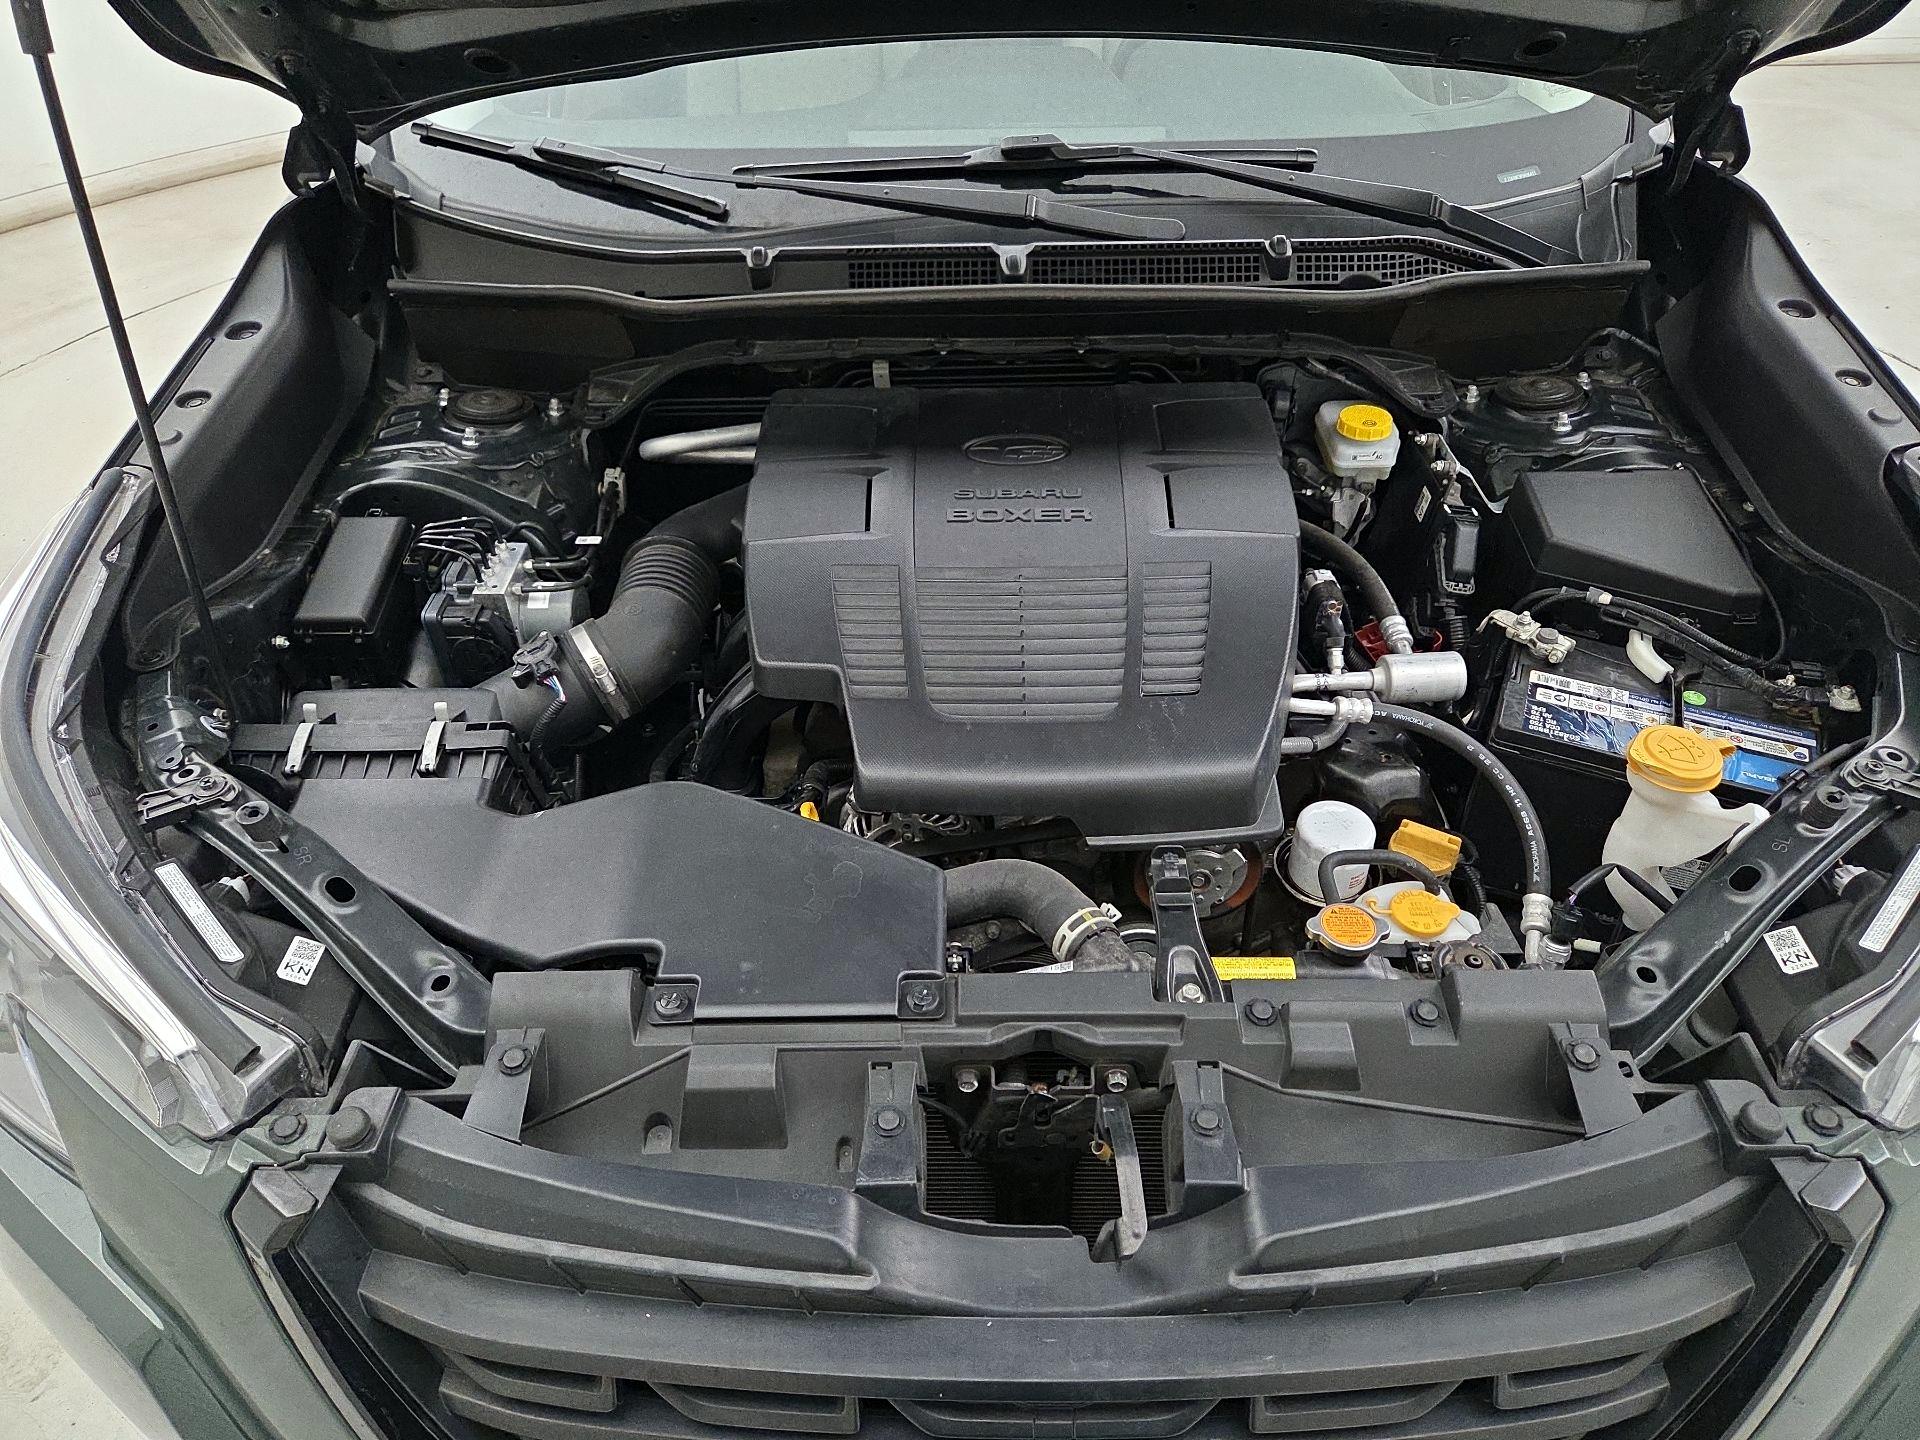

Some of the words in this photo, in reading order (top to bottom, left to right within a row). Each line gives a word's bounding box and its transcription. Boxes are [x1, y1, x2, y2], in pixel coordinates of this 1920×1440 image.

[953, 487, 1082, 499] SUBARU
[946, 507, 1093, 523] BOXER
[1392, 711, 1426, 727] YOKOHAMA
[1493, 768, 1504, 780] CC
[1505, 784, 1516, 796] HP
[1772, 838, 1792, 853] SL
[294, 846, 312, 865] SR
[1530, 840, 1540, 876] YOKOHAMA
[1780, 952, 1811, 966] KN
[284, 961, 312, 976] KN
